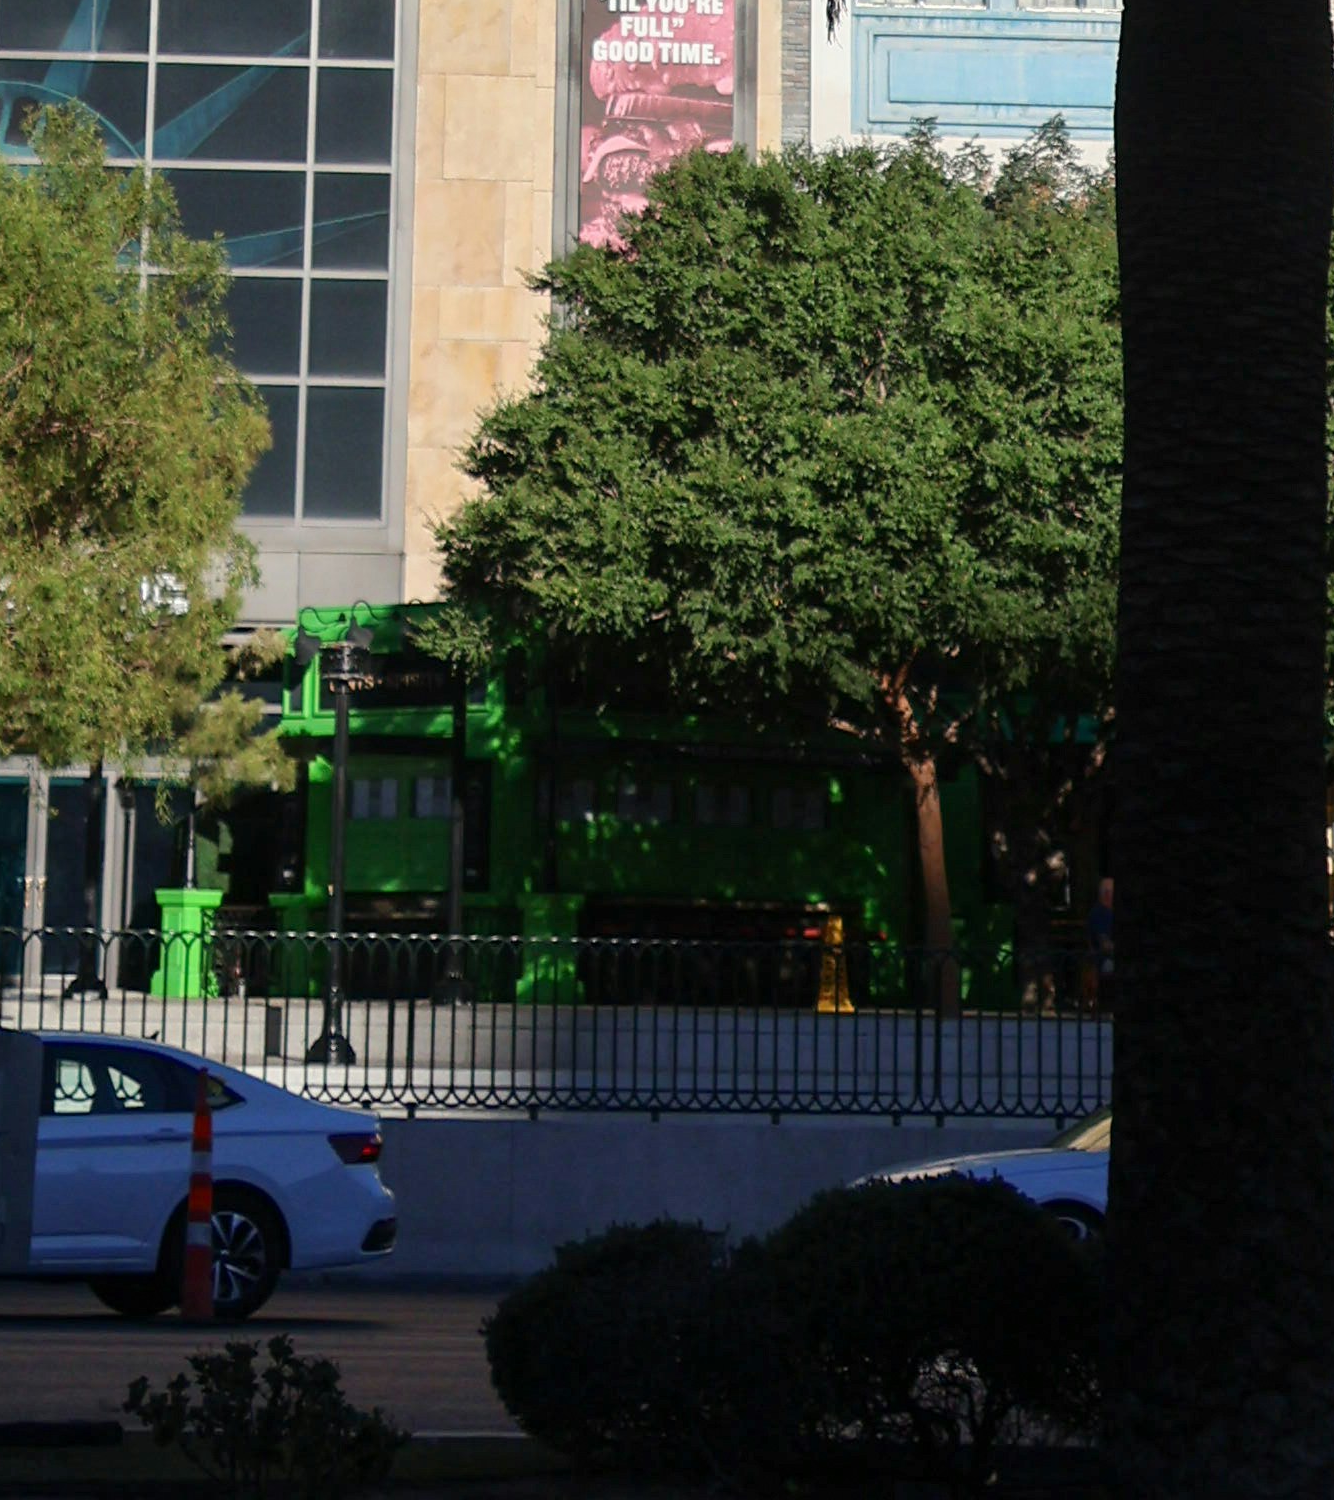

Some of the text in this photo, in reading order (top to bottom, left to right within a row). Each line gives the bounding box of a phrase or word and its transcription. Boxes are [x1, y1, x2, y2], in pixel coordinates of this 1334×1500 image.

[620, 16, 685, 38] FULL”
[592, 40, 722, 65] GOOD TIME.
